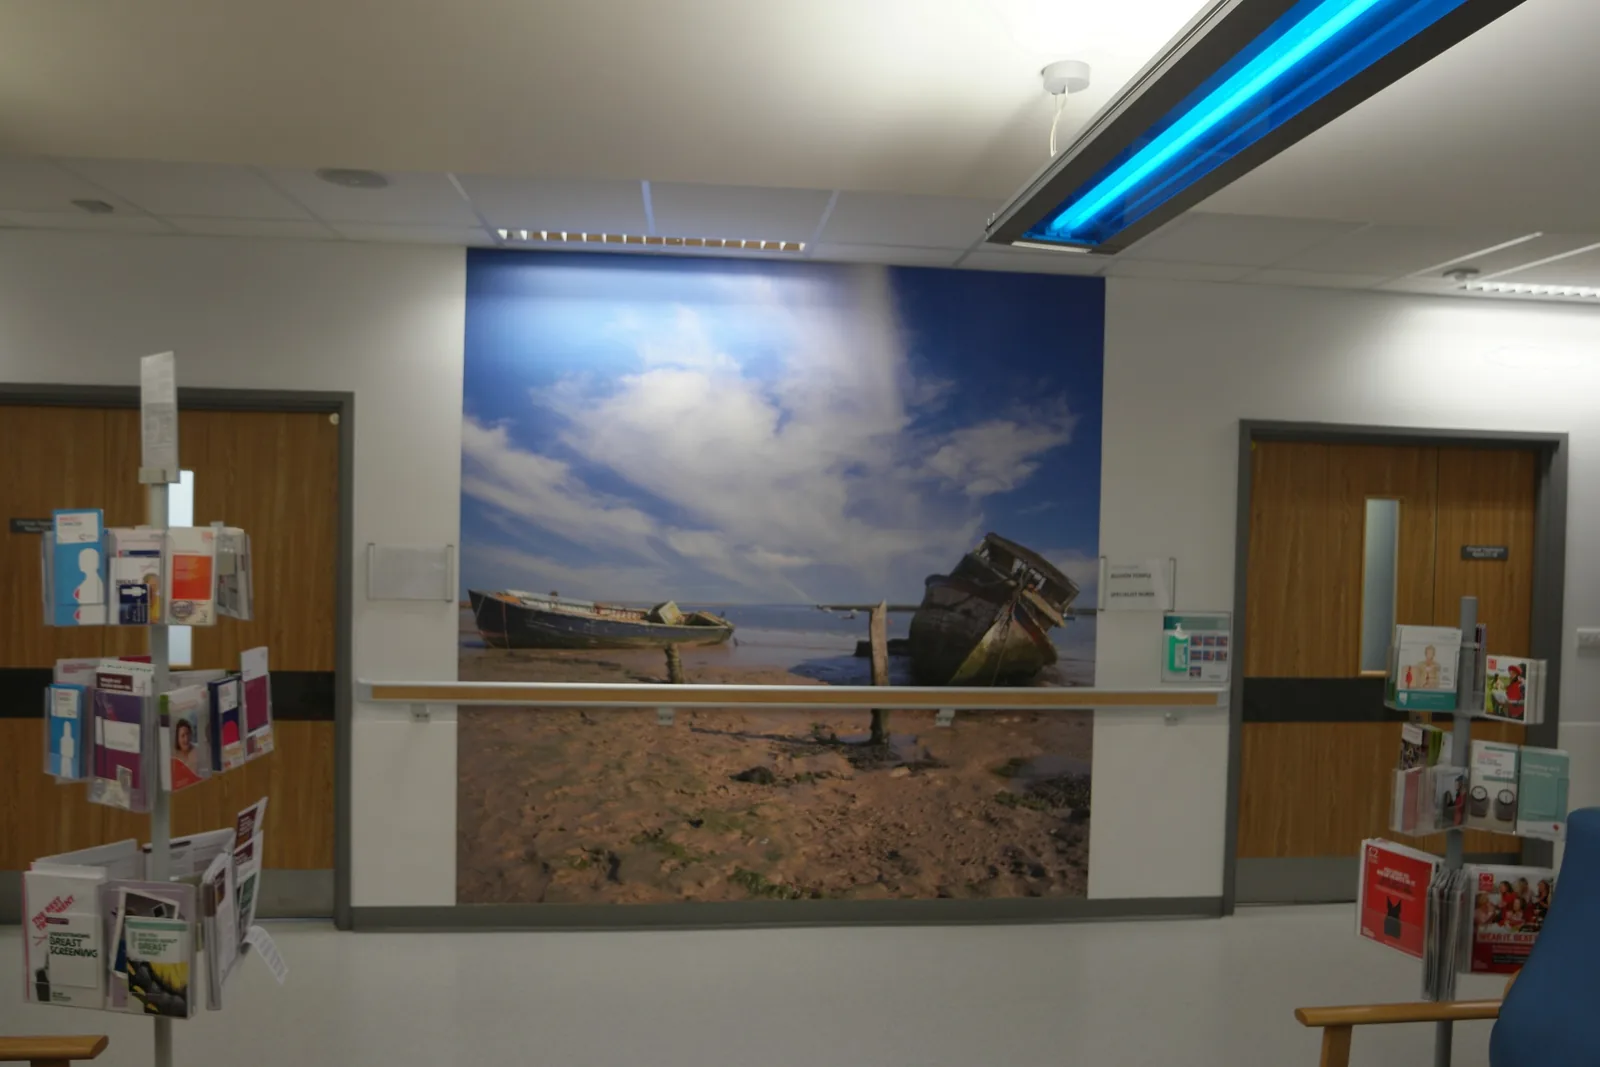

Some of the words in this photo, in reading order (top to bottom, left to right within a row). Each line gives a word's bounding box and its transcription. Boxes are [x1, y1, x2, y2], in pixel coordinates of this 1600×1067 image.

[49, 936, 83, 947] BREAST
[138, 942, 168, 951] BREAST
[49, 945, 98, 958] SCREENING
